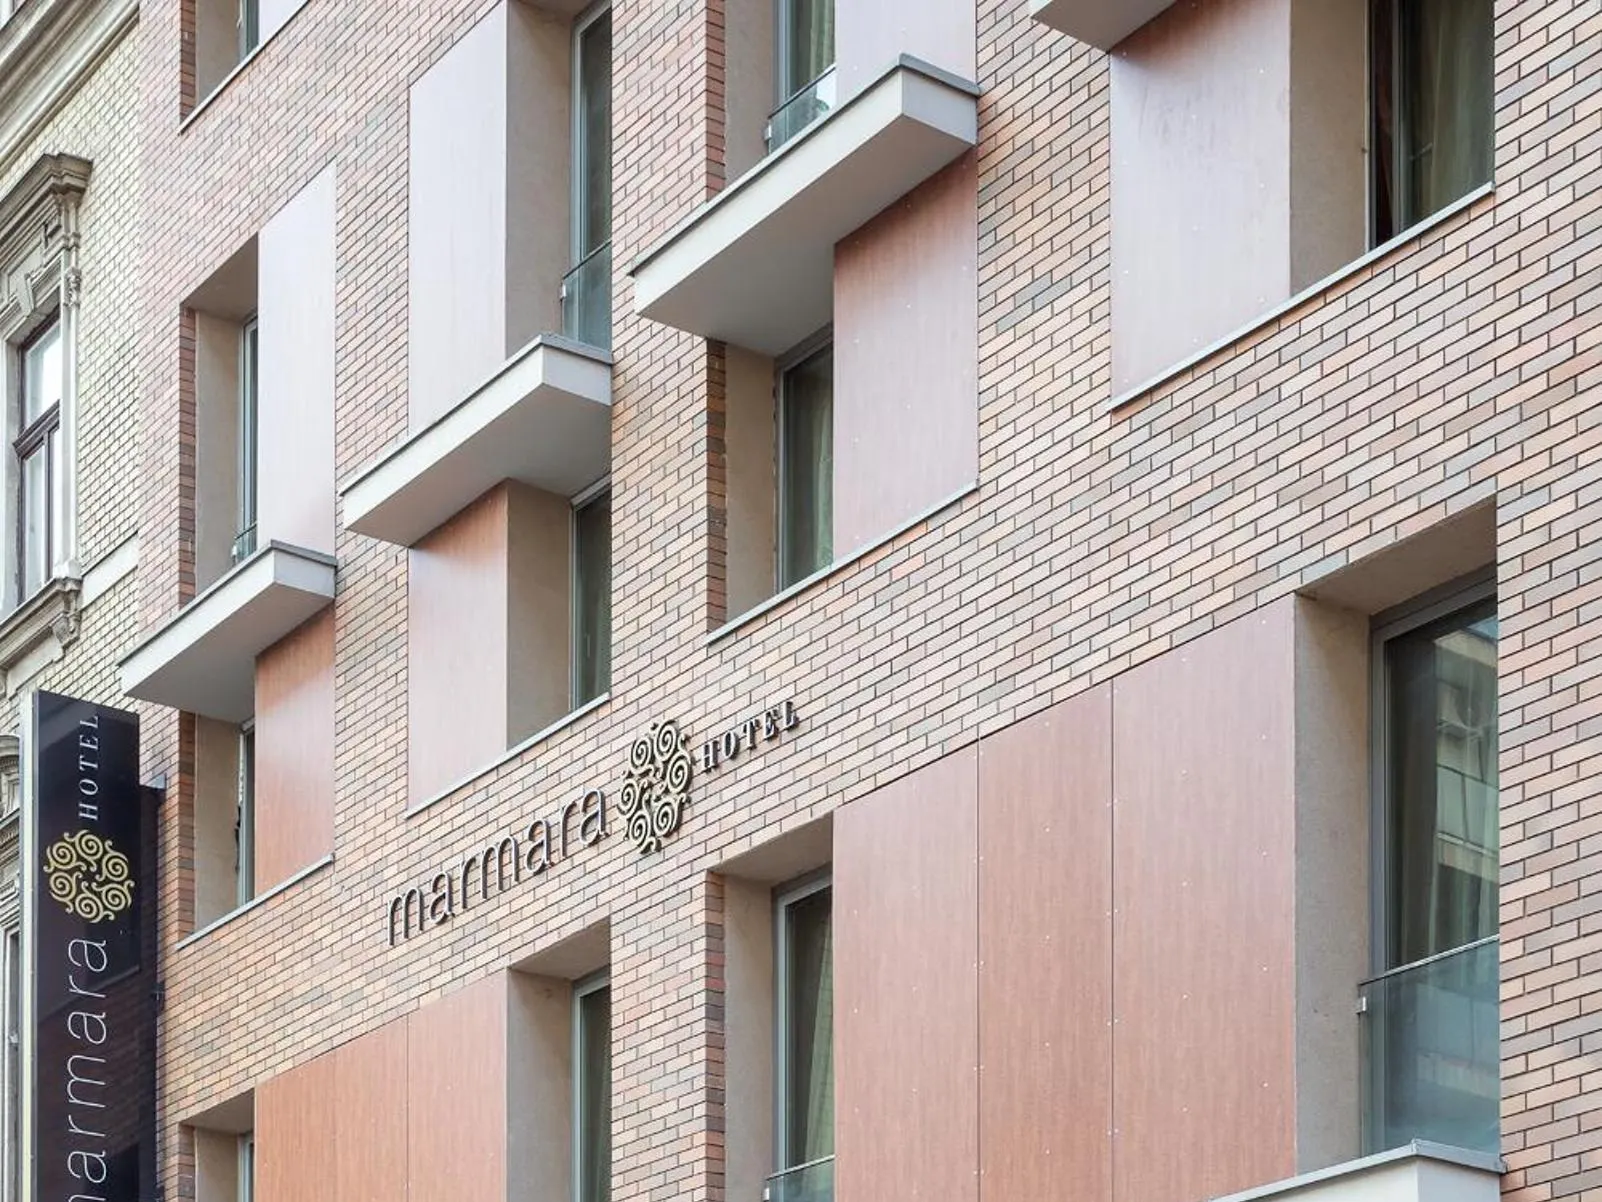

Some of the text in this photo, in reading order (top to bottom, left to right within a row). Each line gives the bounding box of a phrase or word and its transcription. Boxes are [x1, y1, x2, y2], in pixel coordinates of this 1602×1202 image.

[78, 715, 99, 821] HOTEL
[387, 700, 800, 947] marmara HOTEL
